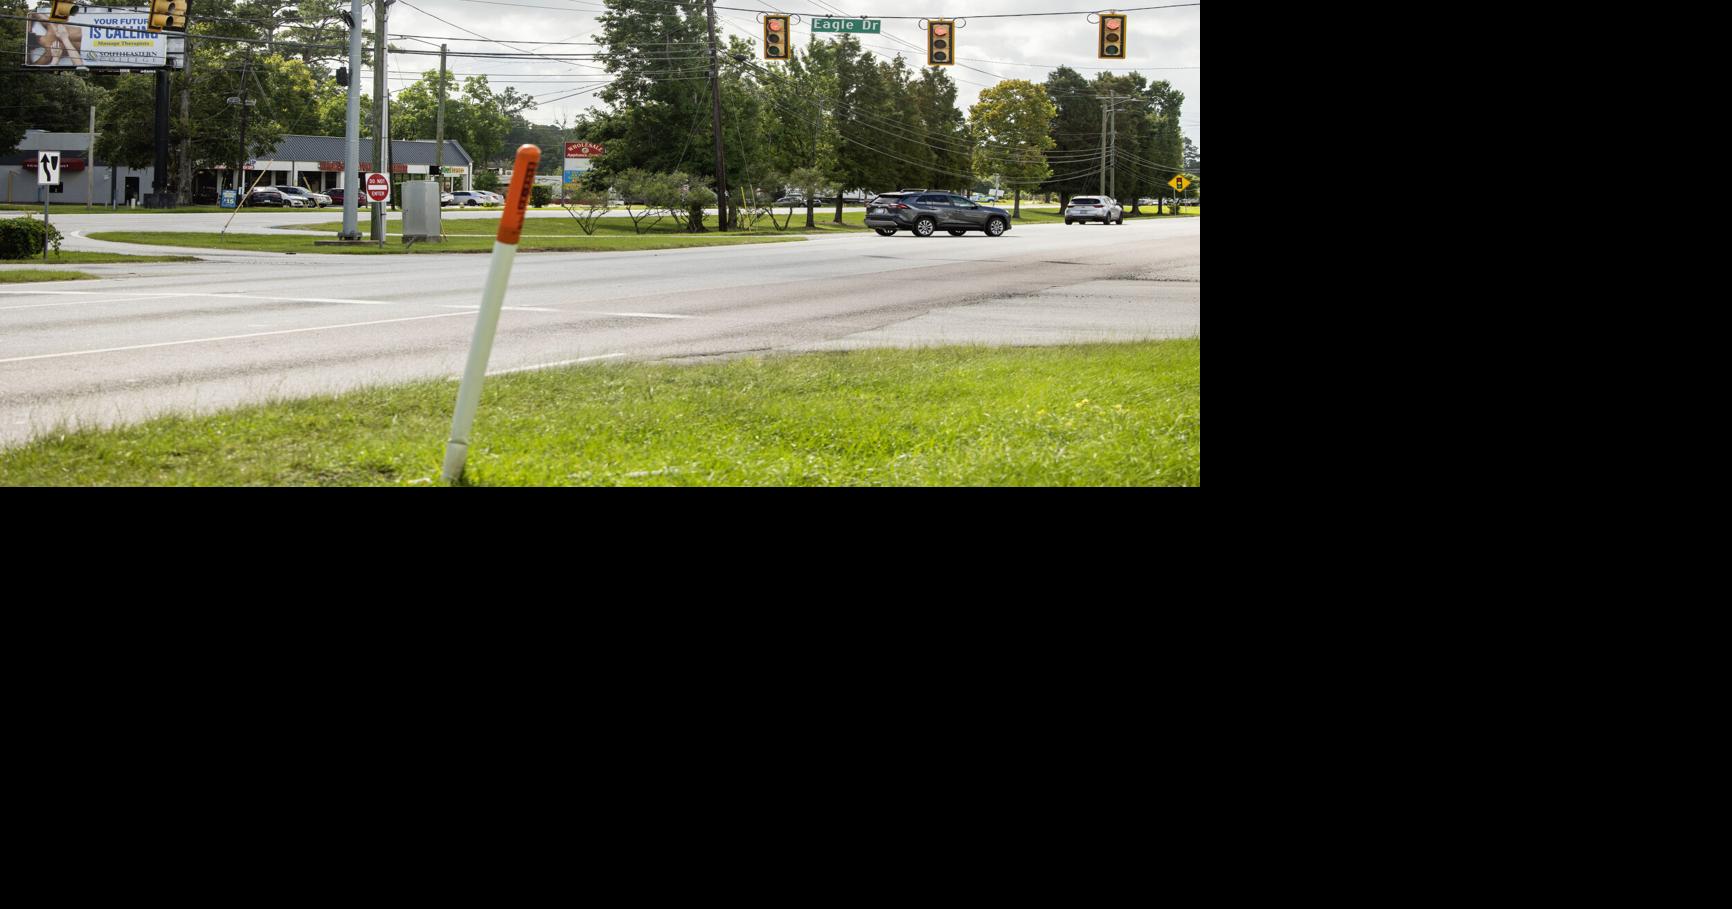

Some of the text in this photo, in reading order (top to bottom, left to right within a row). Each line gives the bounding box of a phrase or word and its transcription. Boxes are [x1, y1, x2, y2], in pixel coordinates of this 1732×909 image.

[813, 19, 879, 32] Eagle Dr
[89, 26, 102, 39] IS
[567, 143, 603, 152] WHOLESALE
